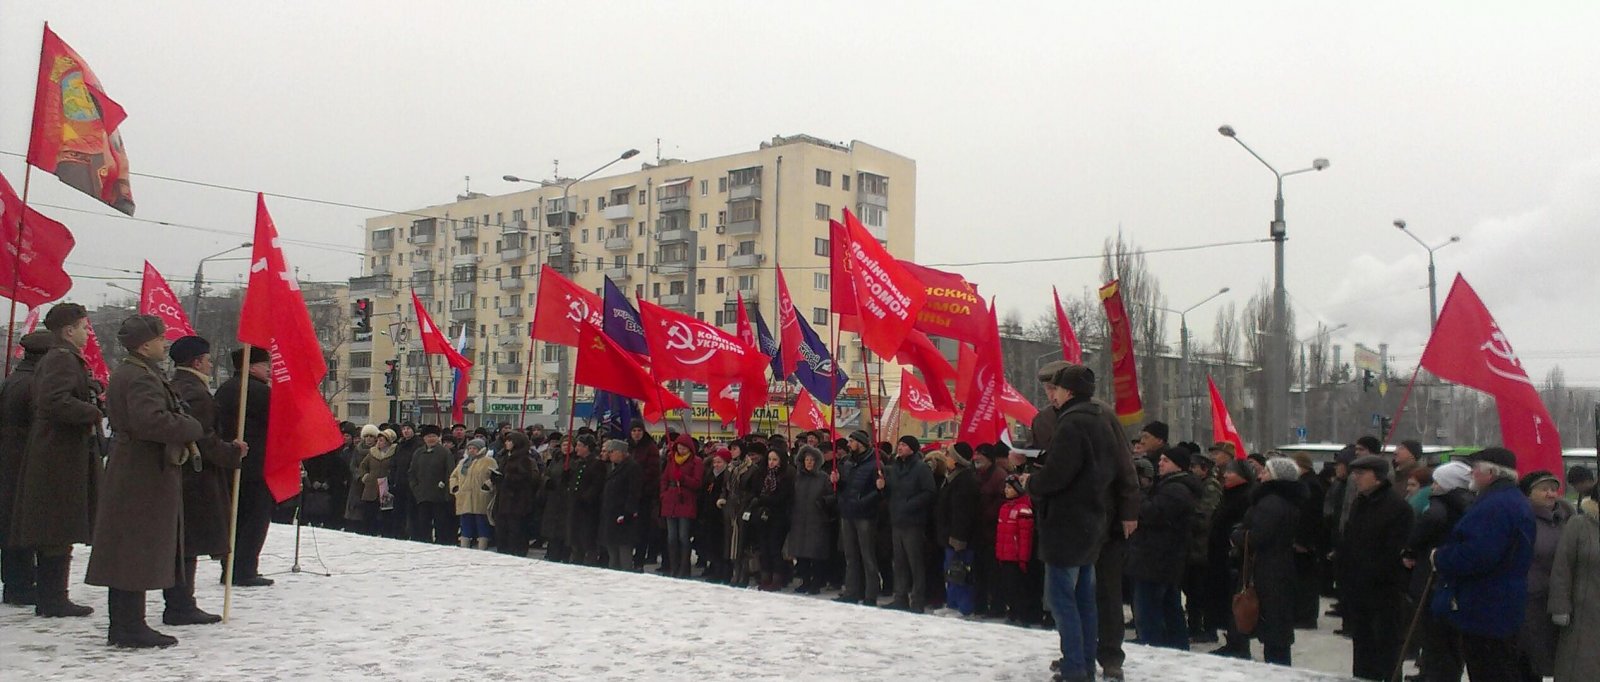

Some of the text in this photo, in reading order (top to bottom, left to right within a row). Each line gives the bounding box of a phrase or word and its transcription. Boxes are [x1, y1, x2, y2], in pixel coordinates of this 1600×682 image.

[861, 268, 908, 320] СОМОЛ
[521, 403, 543, 411] РССИИ
[672, 407, 779, 418] МААЗИН КЛАД
